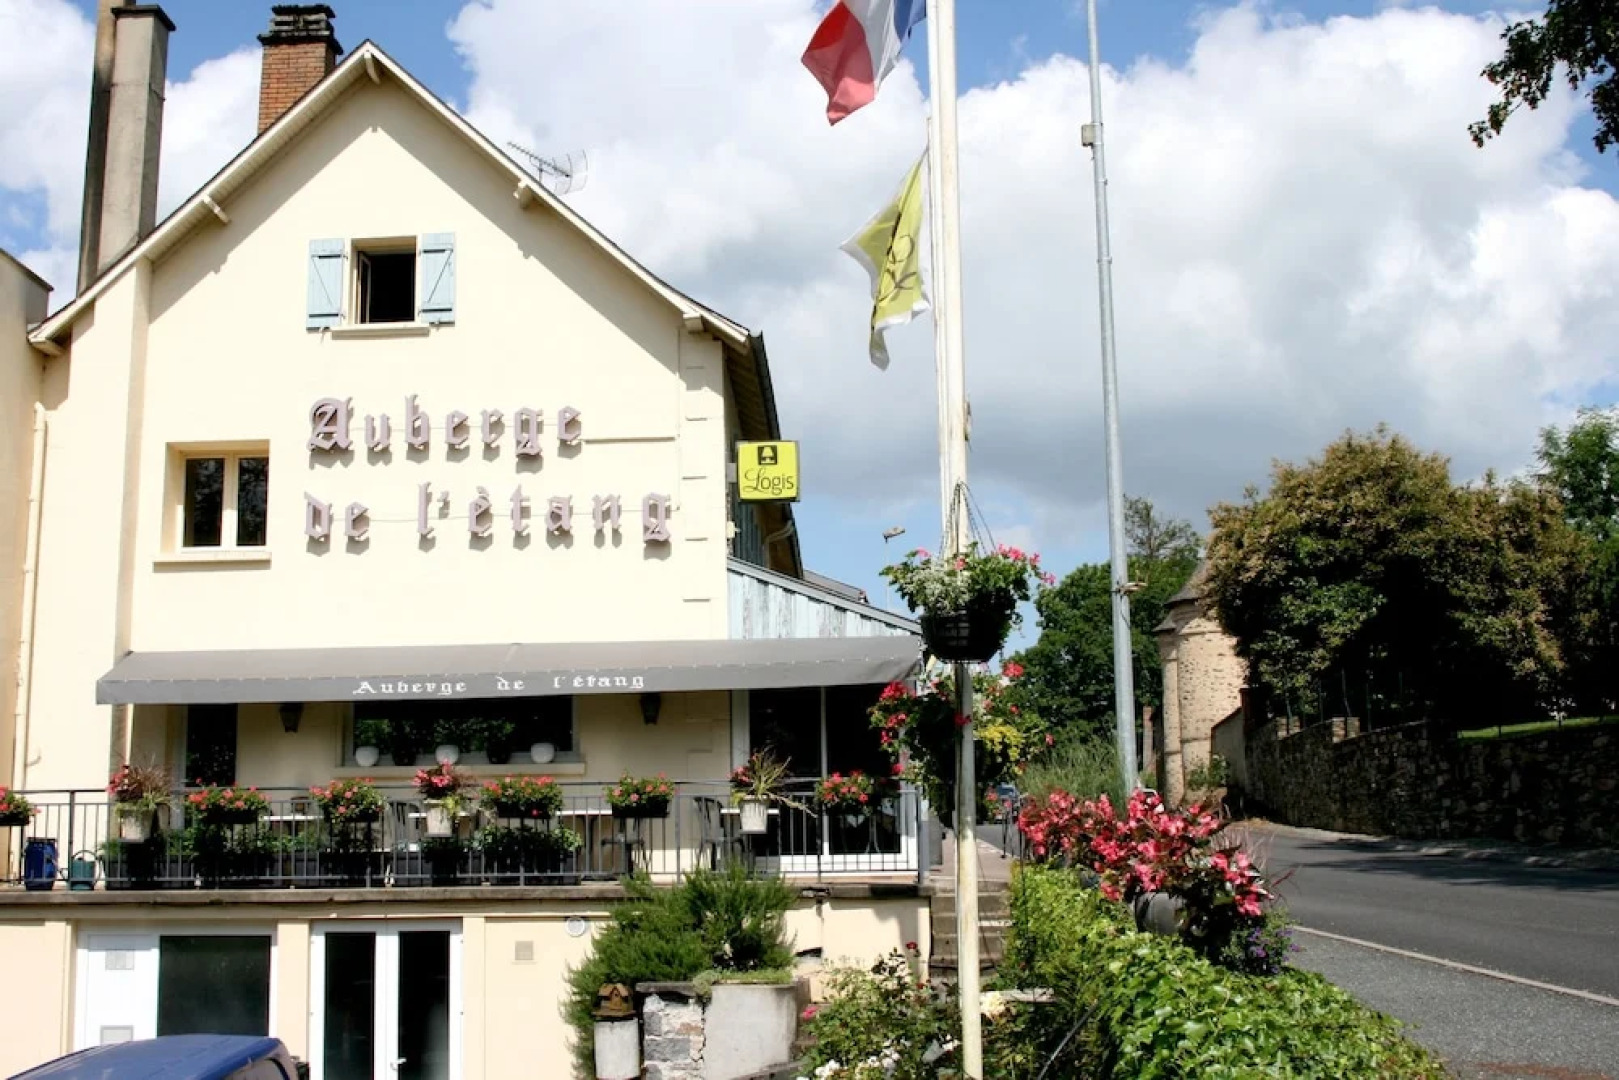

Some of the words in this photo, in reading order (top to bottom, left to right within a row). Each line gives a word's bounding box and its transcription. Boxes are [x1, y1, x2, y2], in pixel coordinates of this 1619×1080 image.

[306, 394, 582, 456] Auberge
[743, 466, 794, 496] Logis
[304, 491, 369, 539] de
[352, 680, 467, 696] Auberge
[496, 675, 525, 691] de
